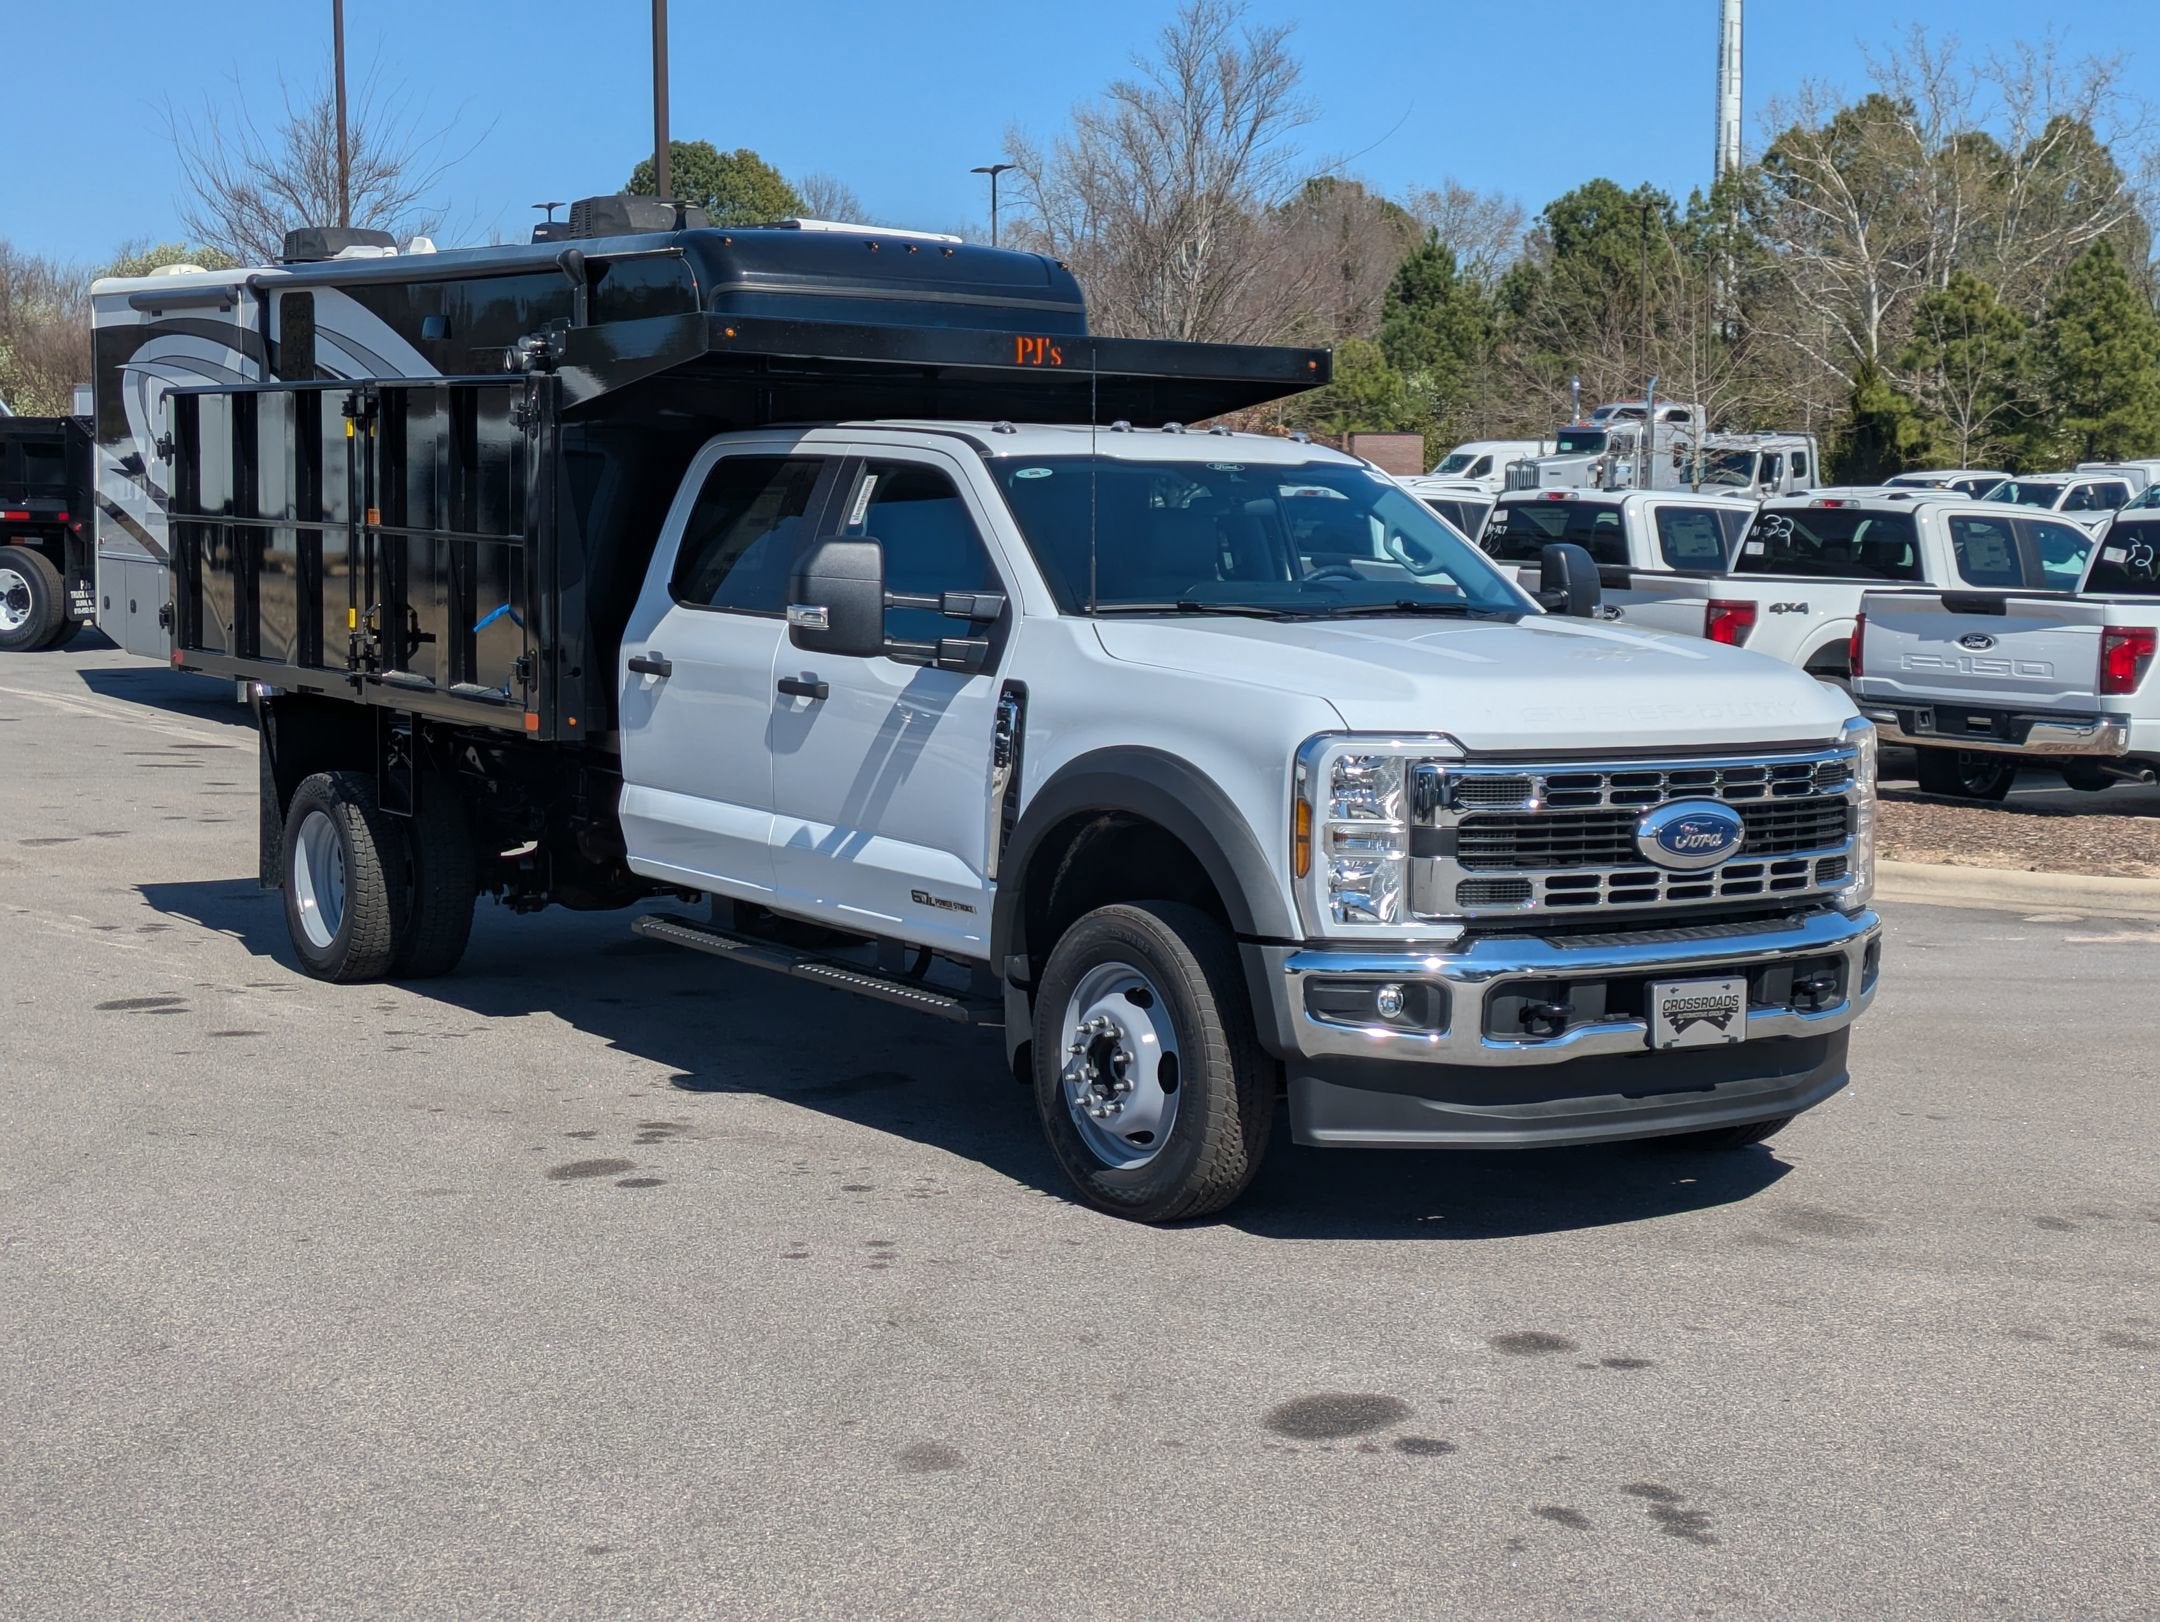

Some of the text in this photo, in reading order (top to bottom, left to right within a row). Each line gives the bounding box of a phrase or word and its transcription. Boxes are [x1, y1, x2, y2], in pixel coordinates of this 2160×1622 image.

[1015, 335, 1062, 366] PJ's
[1964, 635, 1988, 649] Ford
[1900, 652, 2055, 680] F-150
[1002, 690, 1014, 699] XL
[1674, 820, 1724, 850] Ford
[1662, 994, 1740, 1012] CROSSROADS
